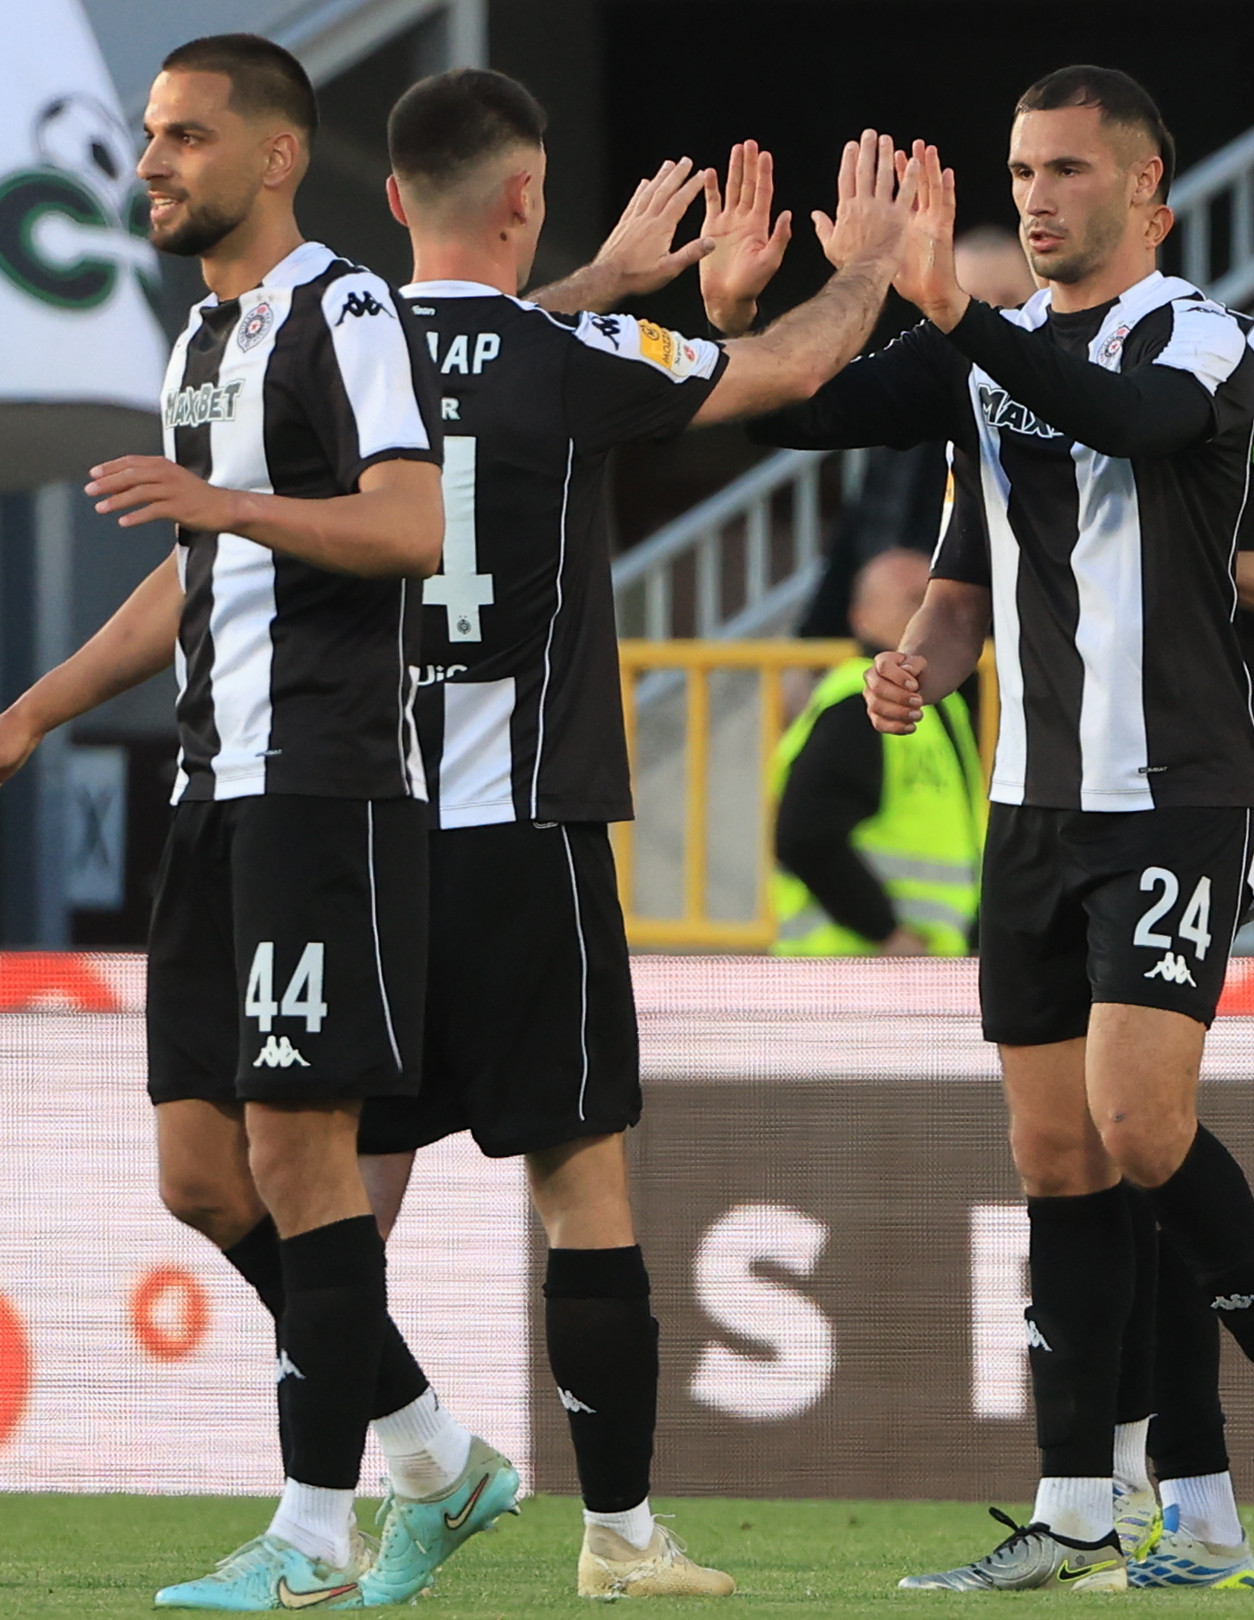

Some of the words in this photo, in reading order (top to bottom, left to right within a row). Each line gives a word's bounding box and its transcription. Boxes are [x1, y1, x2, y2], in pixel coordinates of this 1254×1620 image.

[165, 379, 245, 429] MAXBET
[1133, 866, 1212, 960] 24
[245, 942, 327, 1032] 44
